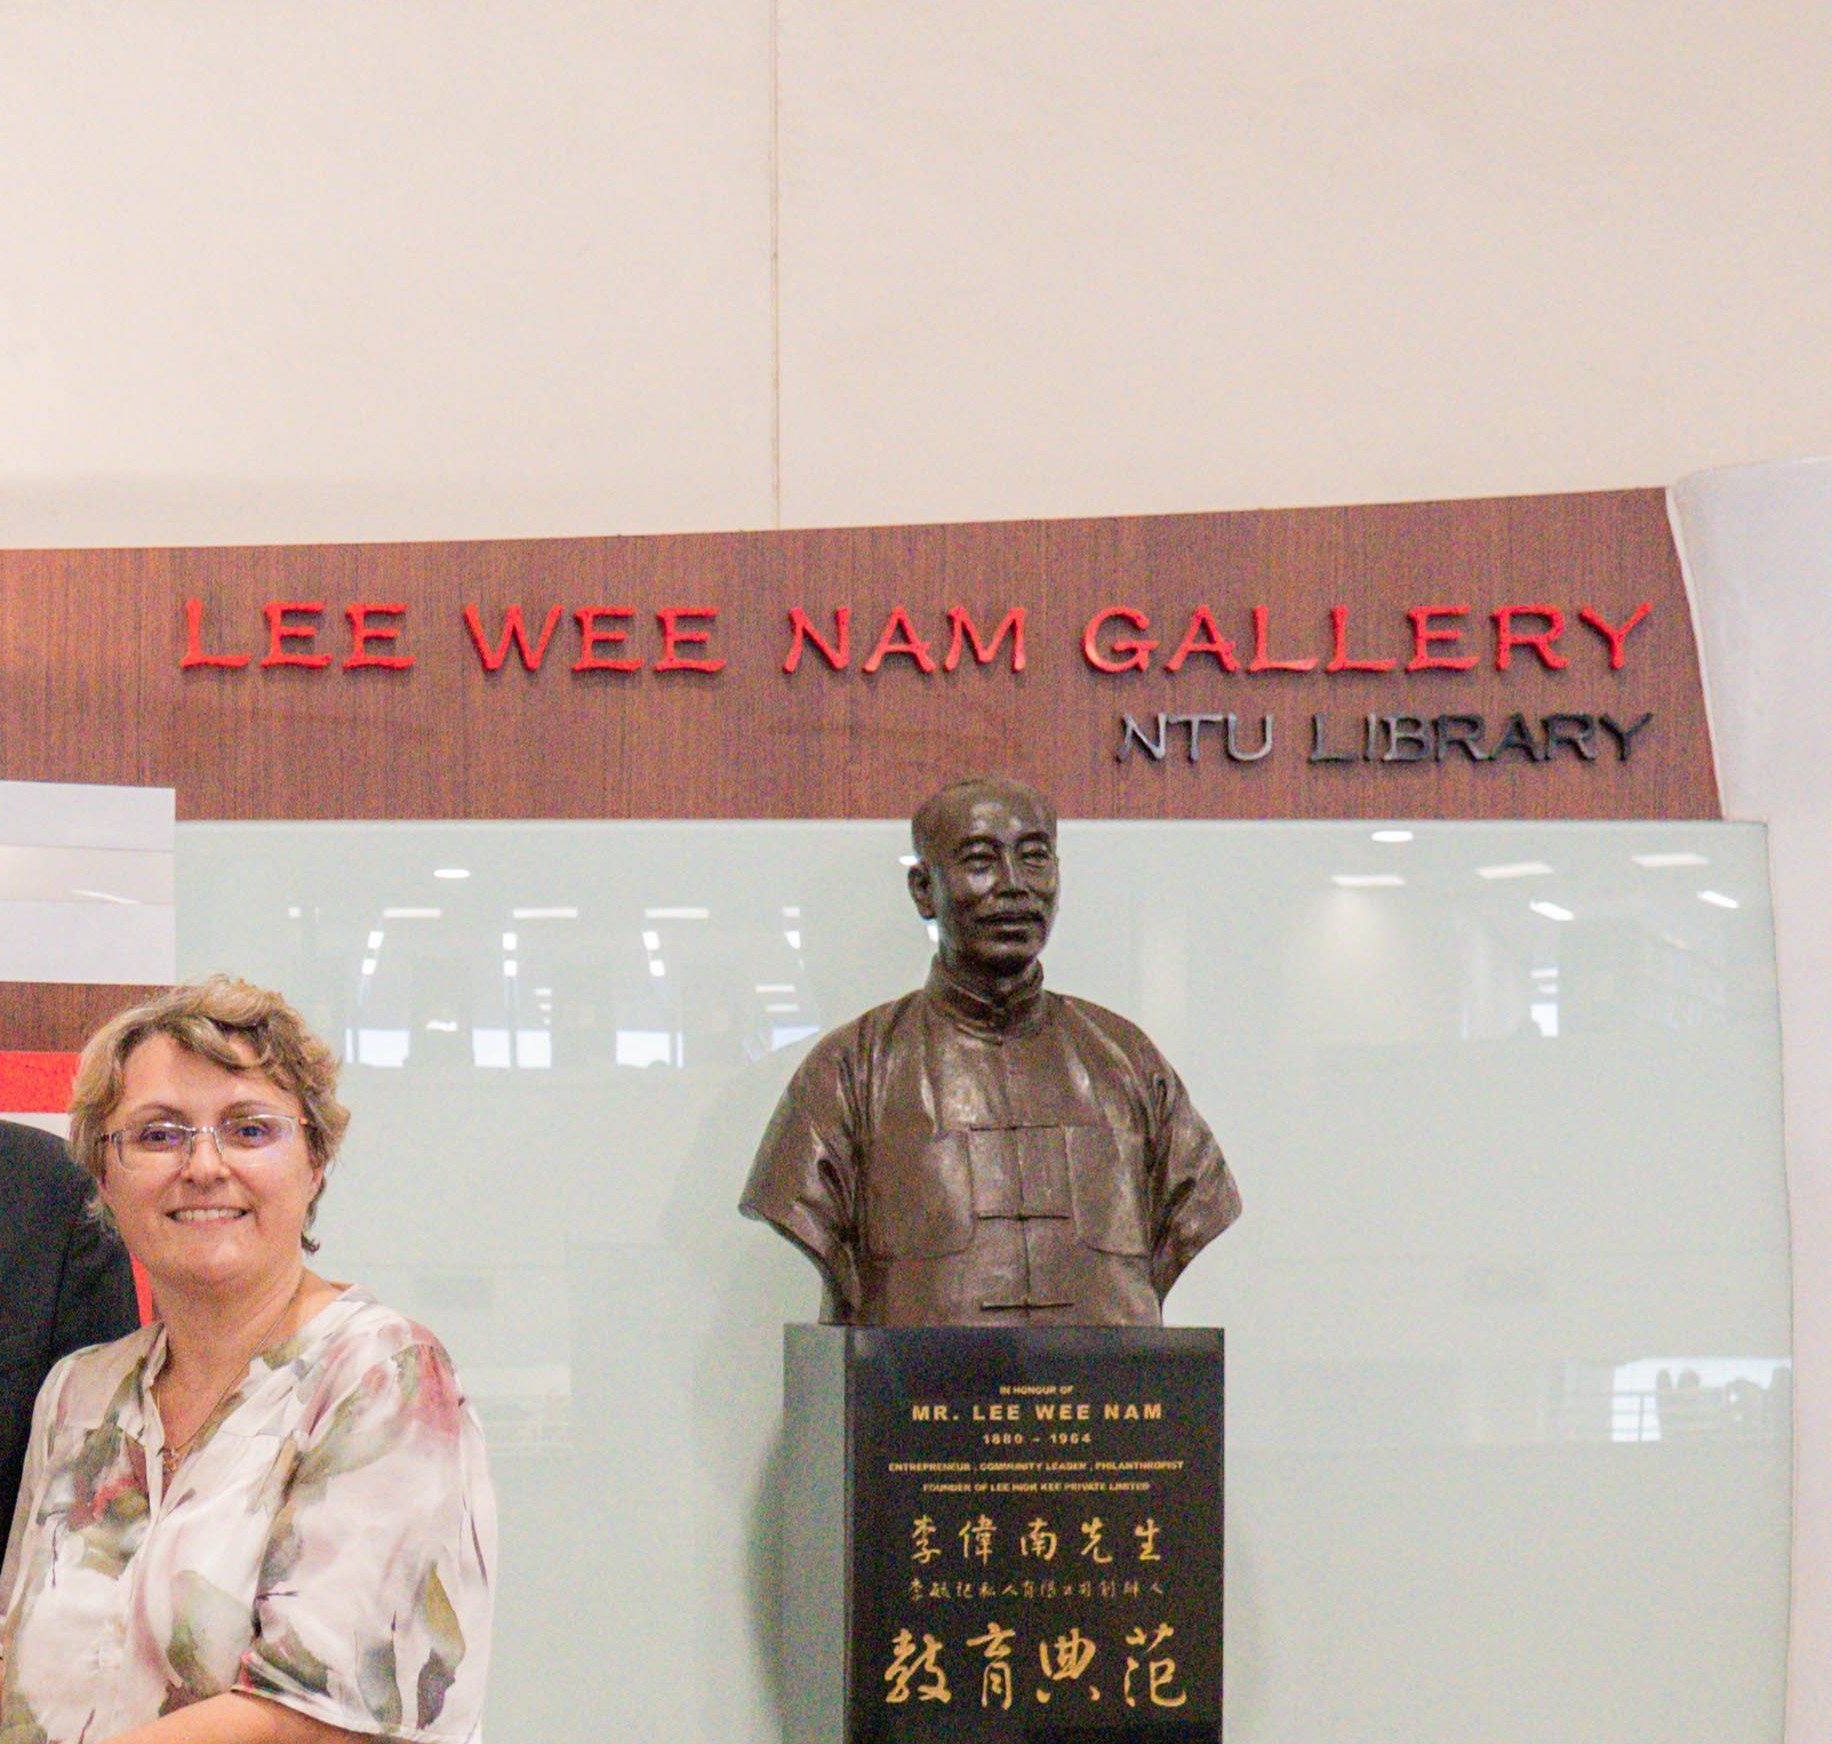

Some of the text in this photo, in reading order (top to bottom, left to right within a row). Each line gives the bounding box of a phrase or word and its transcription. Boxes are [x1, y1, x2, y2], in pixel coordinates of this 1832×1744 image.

[179, 598, 1657, 675] LEE WEE NAM GALLERY
[1112, 712, 1654, 764] NTU LIBRARY
[999, 1385, 1074, 1395] IN HONOUR OF
[912, 1403, 1162, 1421] MR. LEE WEE NAM
[1050, 1433, 1091, 1444] 1964
[911, 1514, 1161, 1566] 李偉南先生
